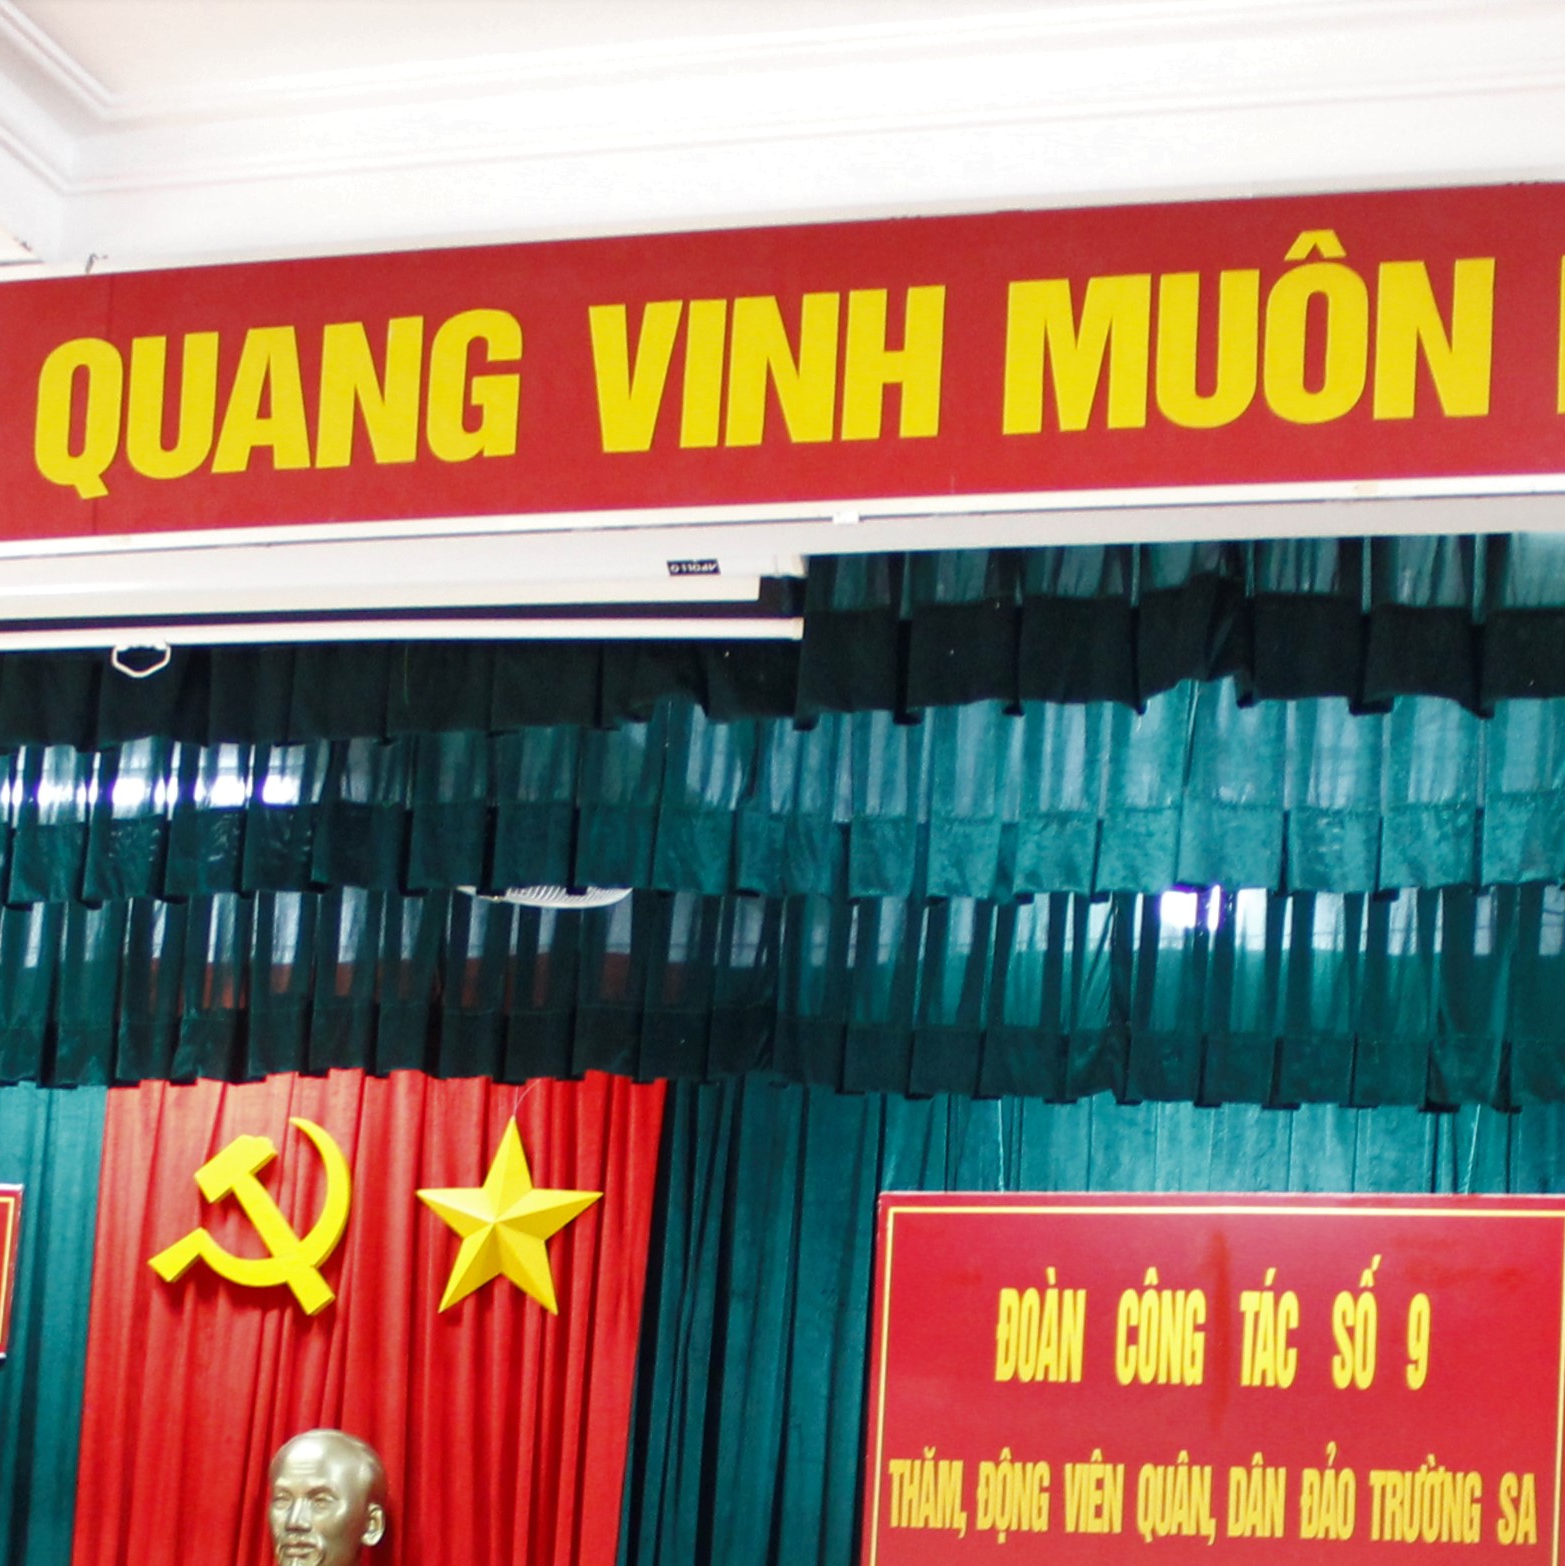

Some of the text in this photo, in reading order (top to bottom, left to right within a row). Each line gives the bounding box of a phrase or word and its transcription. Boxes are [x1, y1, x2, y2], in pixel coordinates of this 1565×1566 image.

[34, 308, 523, 500] QUANG
[588, 285, 946, 453] VINH
[1002, 229, 1496, 435] MUÔN
[994, 1254, 1431, 1390] ĐOÀN CÔNG TÁC SỐ 9
[888, 1441, 1538, 1546] THĂM, ĐỘNG VIÊN QUÂN, DÂN ĐẢO TRƯỜNG SA
